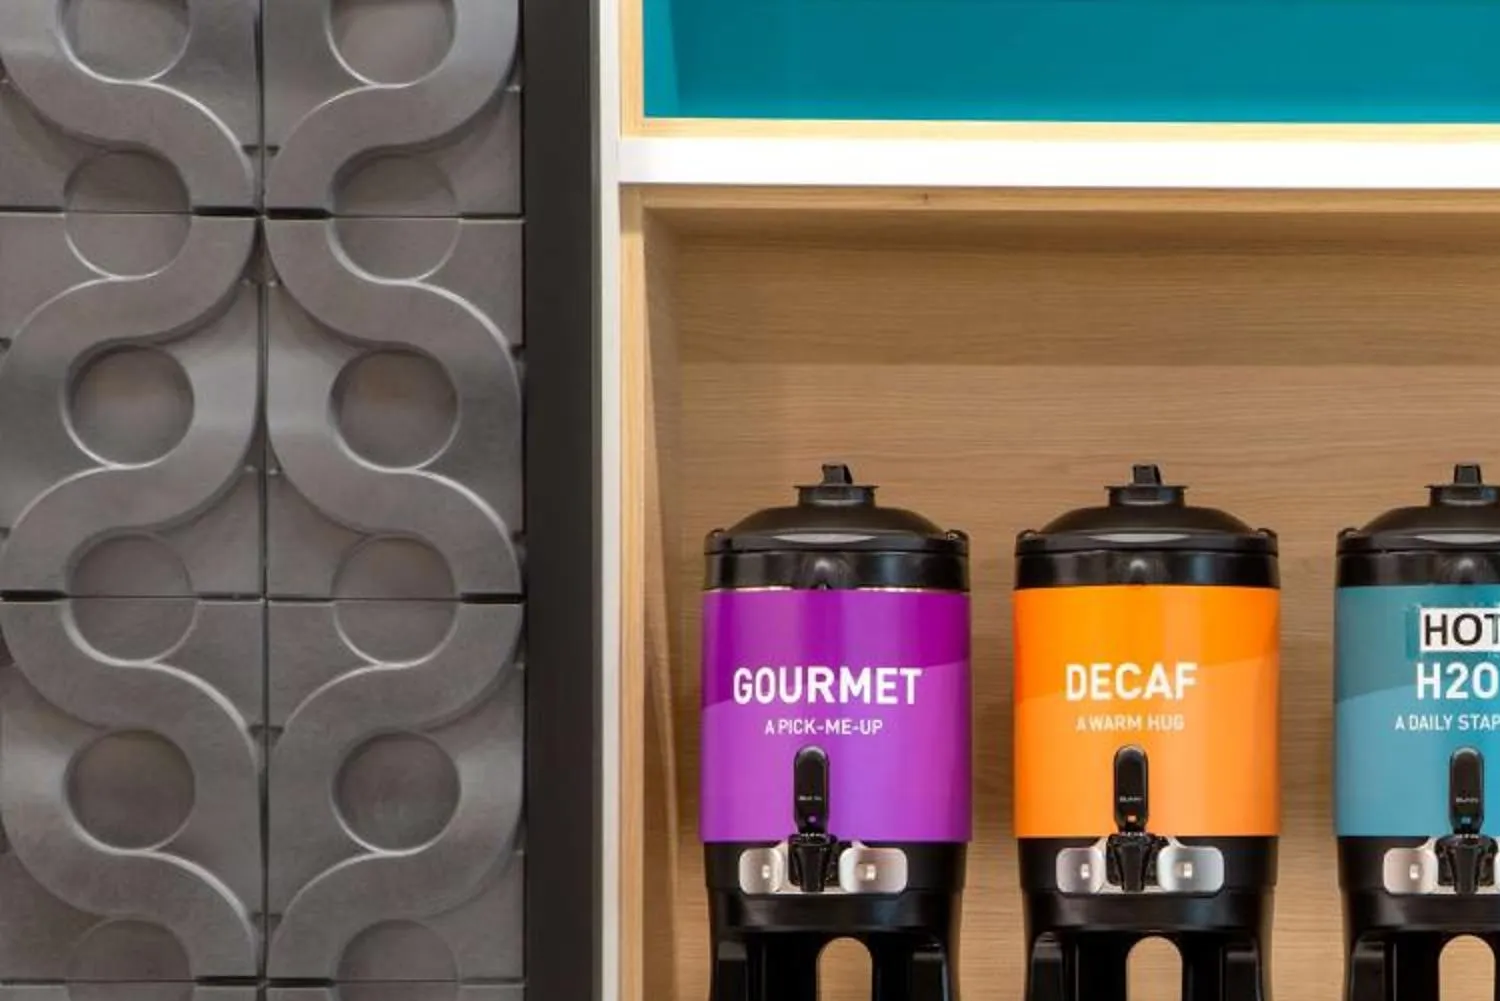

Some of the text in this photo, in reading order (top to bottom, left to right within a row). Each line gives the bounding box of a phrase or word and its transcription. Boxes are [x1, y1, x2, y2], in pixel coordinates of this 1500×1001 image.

[733, 666, 923, 705] GOURMET
[1065, 662, 1198, 701] DECAF
[765, 718, 883, 735] A PICK-ME-UP
[1076, 715, 1185, 731] A WARM HUG
[1395, 715, 1405, 731] A
[1408, 714, 1452, 731] DAILY
